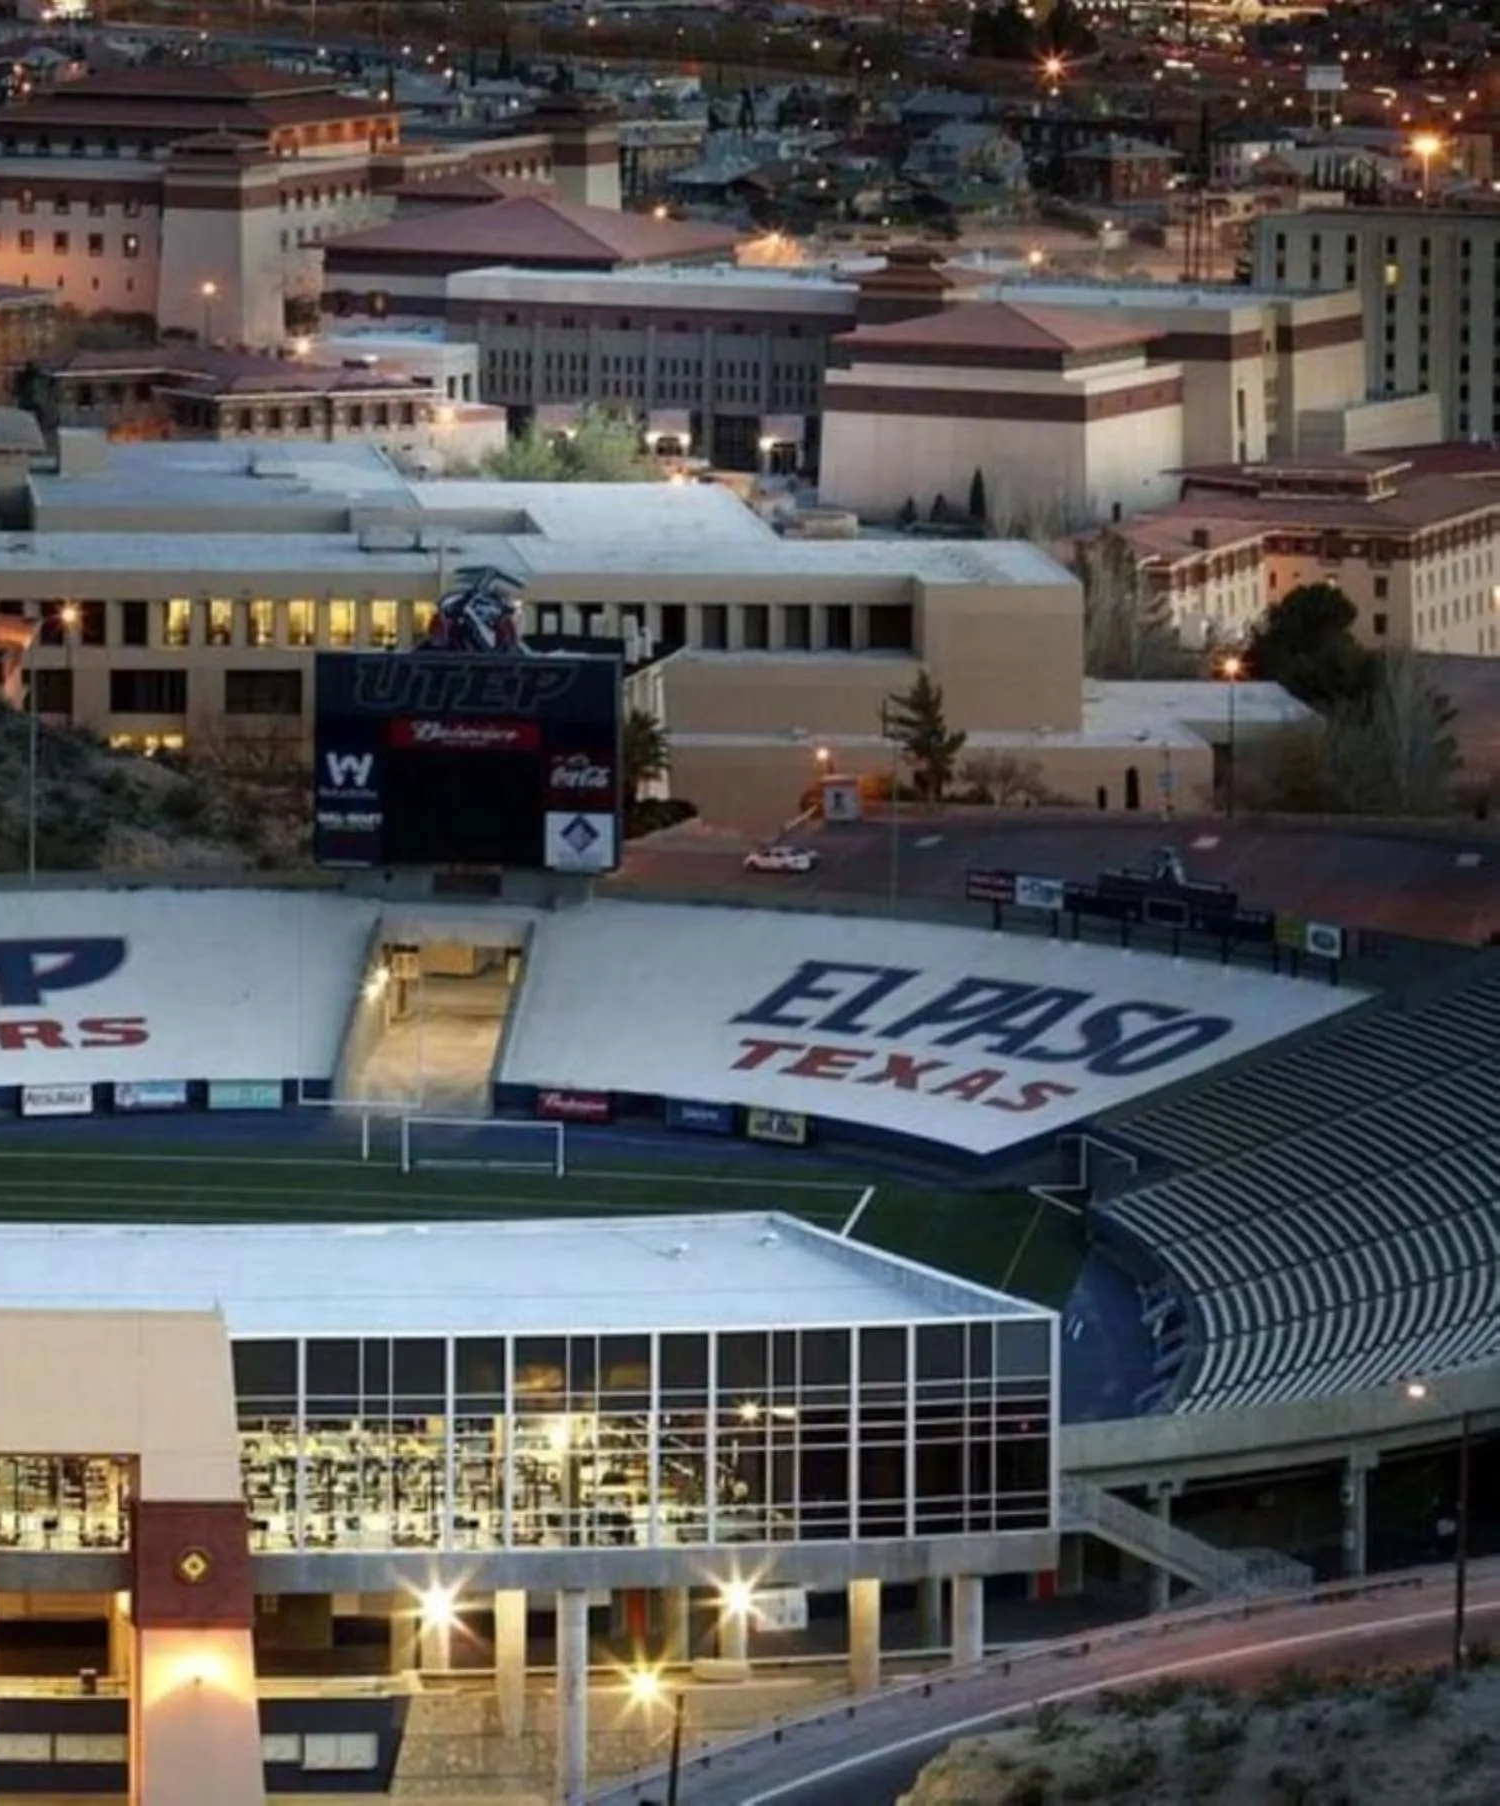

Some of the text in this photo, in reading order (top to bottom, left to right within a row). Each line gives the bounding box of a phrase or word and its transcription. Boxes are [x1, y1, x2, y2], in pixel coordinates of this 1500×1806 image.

[354, 658, 581, 712] UTEP
[728, 960, 1234, 1076] EL PASO
[730, 1038, 1079, 1112] TEXAS
